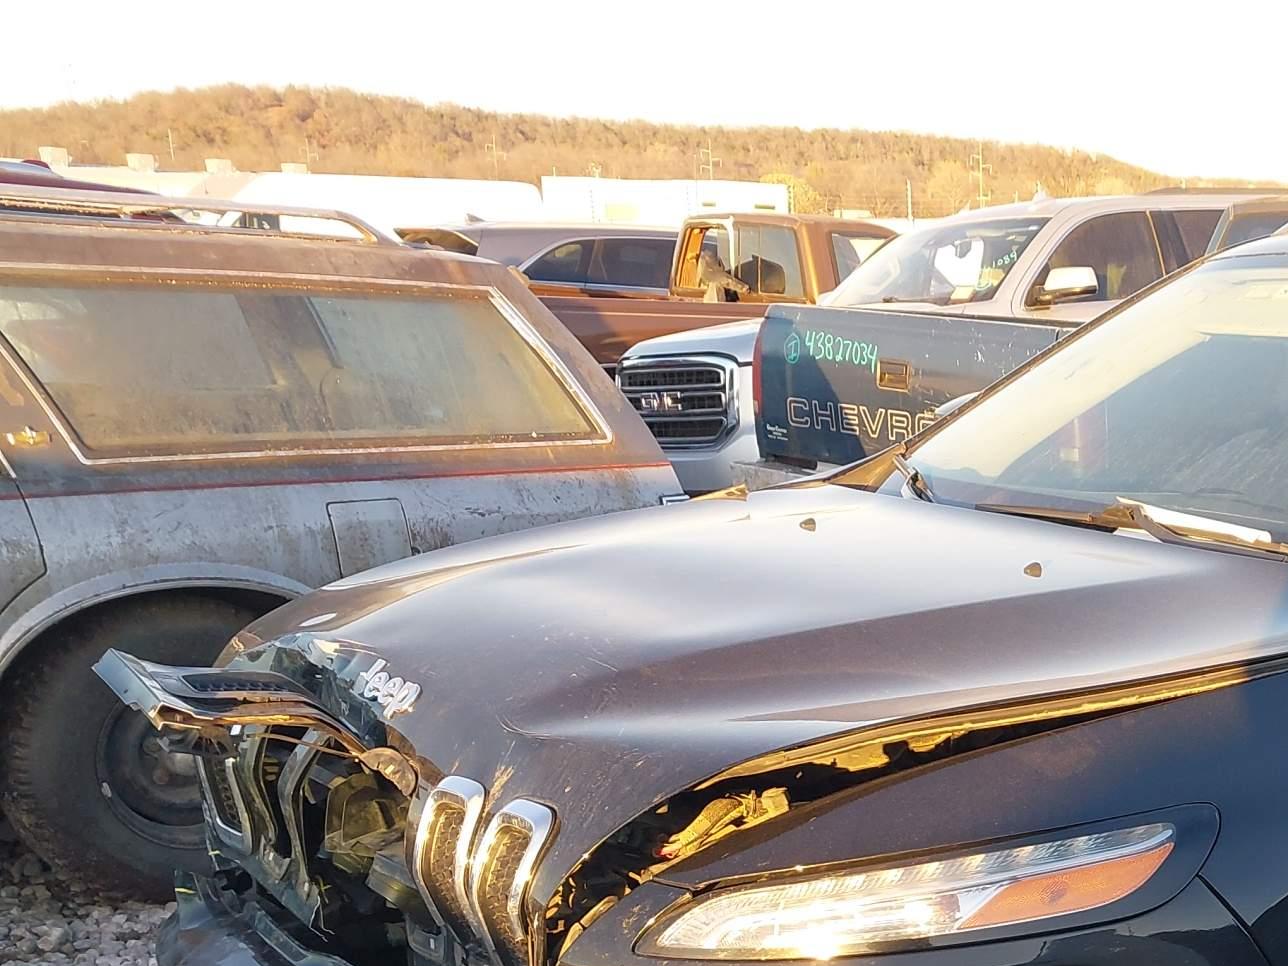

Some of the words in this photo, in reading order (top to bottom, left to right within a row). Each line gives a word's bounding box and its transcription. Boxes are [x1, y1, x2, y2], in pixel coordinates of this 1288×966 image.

[805, 330, 878, 373] 43827034
[641, 391, 682, 411] GMC
[354, 659, 421, 720] Jeep
